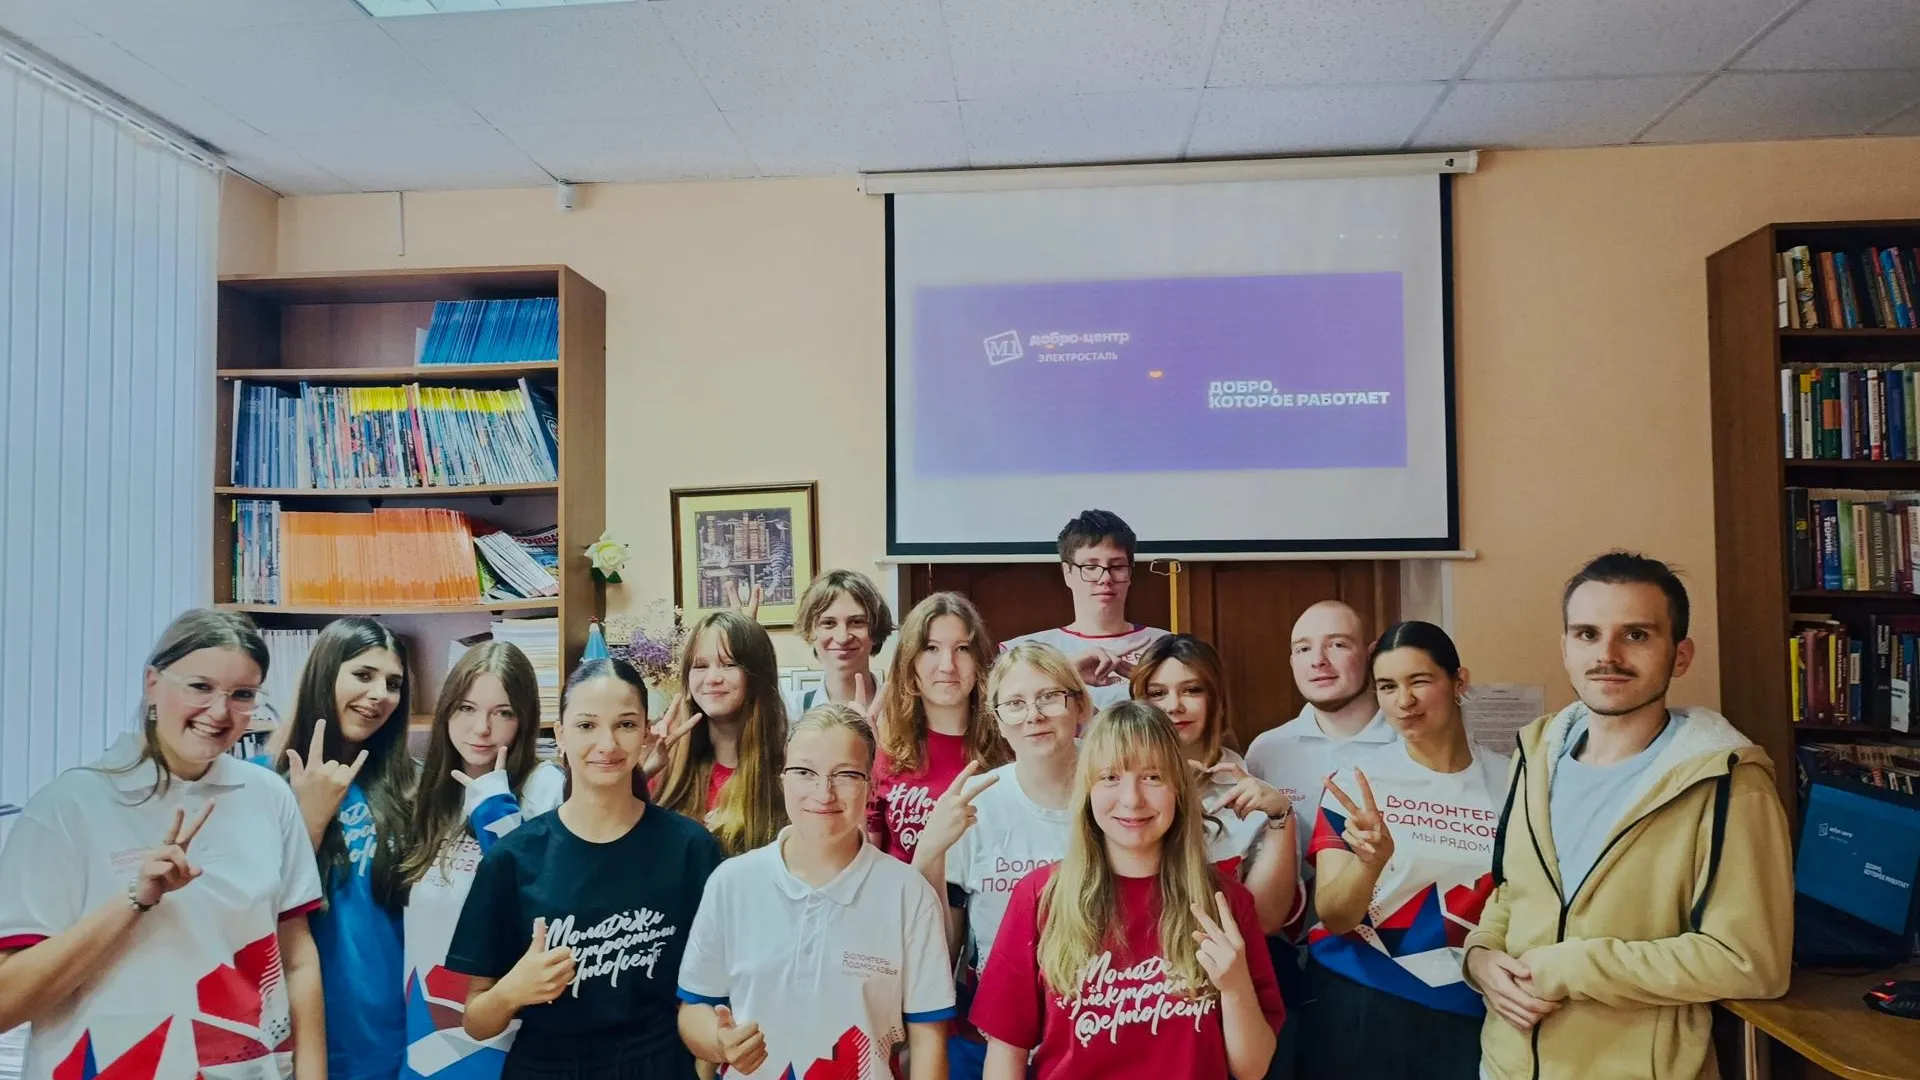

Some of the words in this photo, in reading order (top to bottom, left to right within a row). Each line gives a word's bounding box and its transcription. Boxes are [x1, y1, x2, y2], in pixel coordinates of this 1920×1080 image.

[1029, 331, 1130, 347] добро-центр
[1038, 351, 1119, 363] ЭЛЕКТРОСТАЛЬ
[1208, 380, 1279, 396] ДОБРО,
[1208, 393, 1294, 409] КОТОРОЕ
[1298, 391, 1391, 407] РАБОТАЕТ
[1386, 795, 1496, 821] ВОЛОНТЕР
[1379, 811, 1498, 839] ОДМОСКОВ
[1411, 831, 1436, 843] МЫ
[1439, 837, 1491, 853] РЯДОМ
